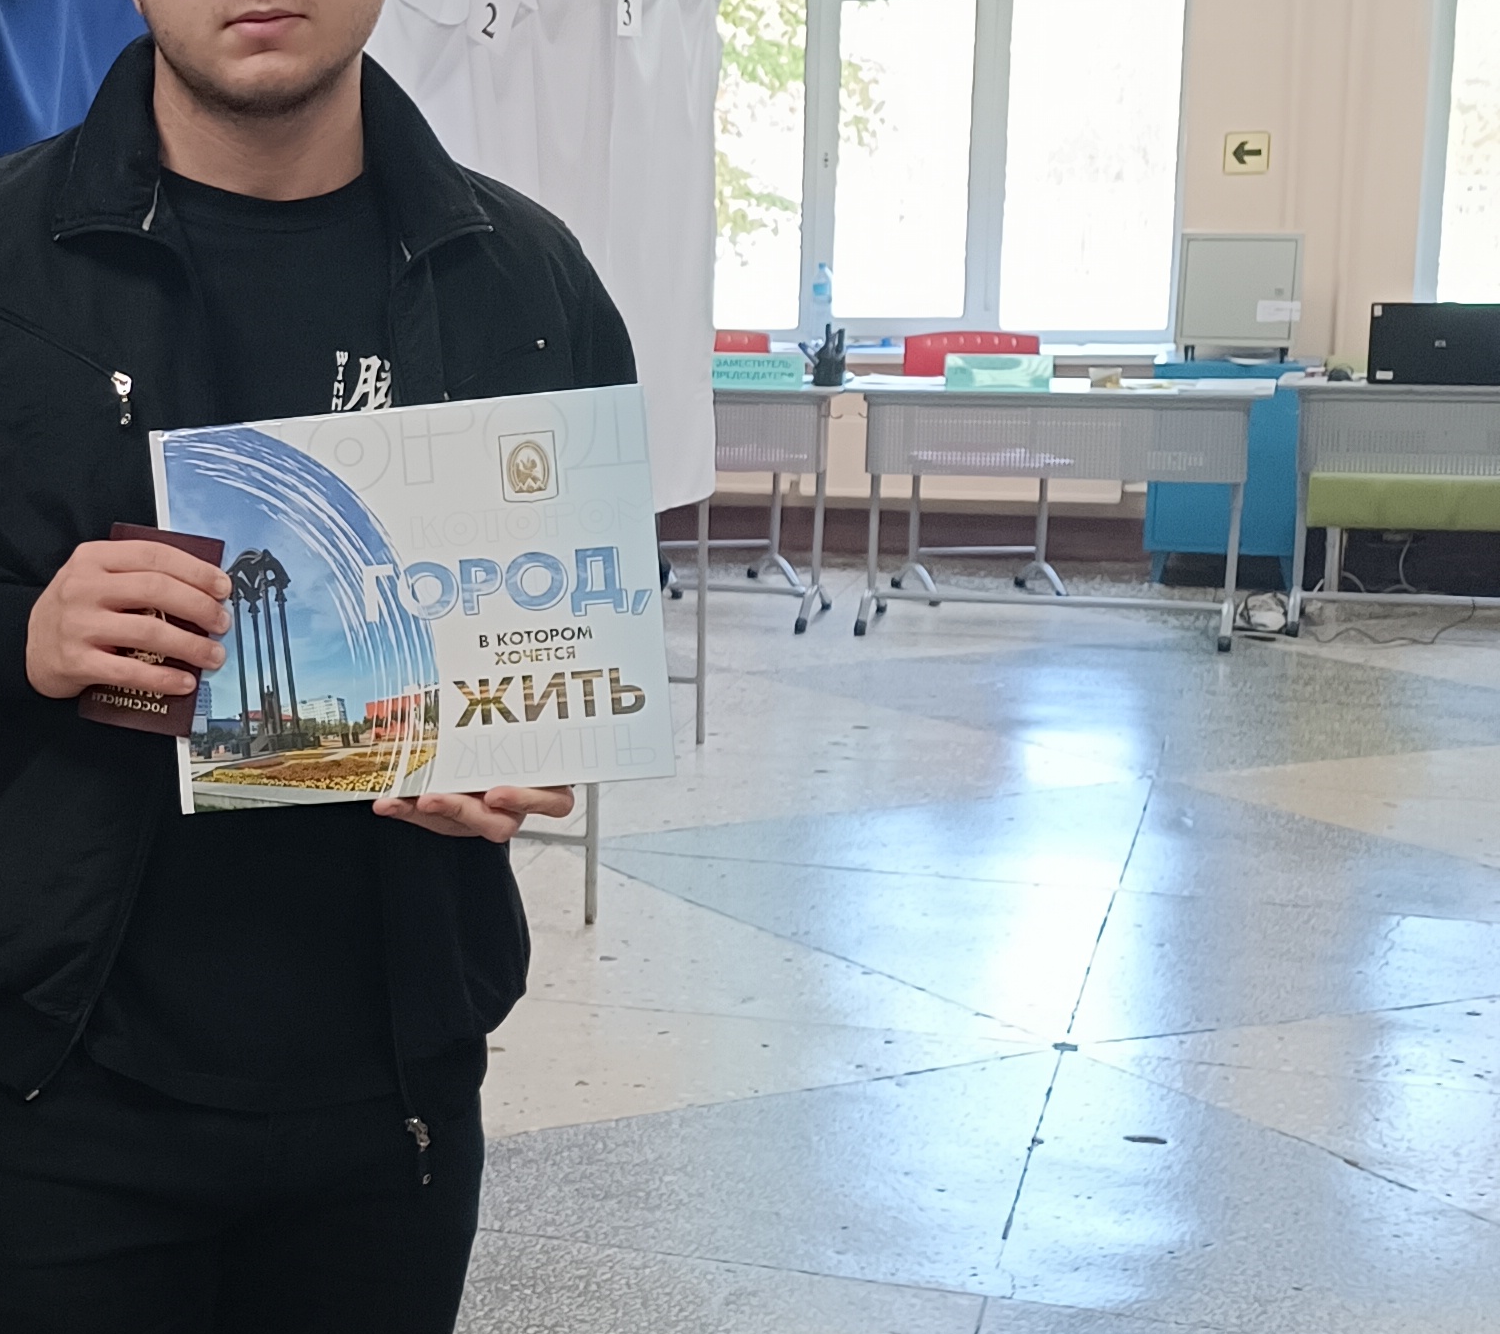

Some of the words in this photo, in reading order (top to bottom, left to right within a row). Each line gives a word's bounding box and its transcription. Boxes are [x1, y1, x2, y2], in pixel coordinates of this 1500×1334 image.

[481, 2, 498, 38] 2
[715, 359, 792, 368] ЗАМЕСТИТЕЛЬ
[363, 546, 653, 622] ГОРОД,
[479, 634, 489, 648] В
[497, 625, 593, 646] КОТОРОМ
[494, 645, 577, 665] ХОЧЕТСЯ
[453, 667, 646, 728] ЖИТЬ
[454, 723, 657, 778] ЖИТЬ
